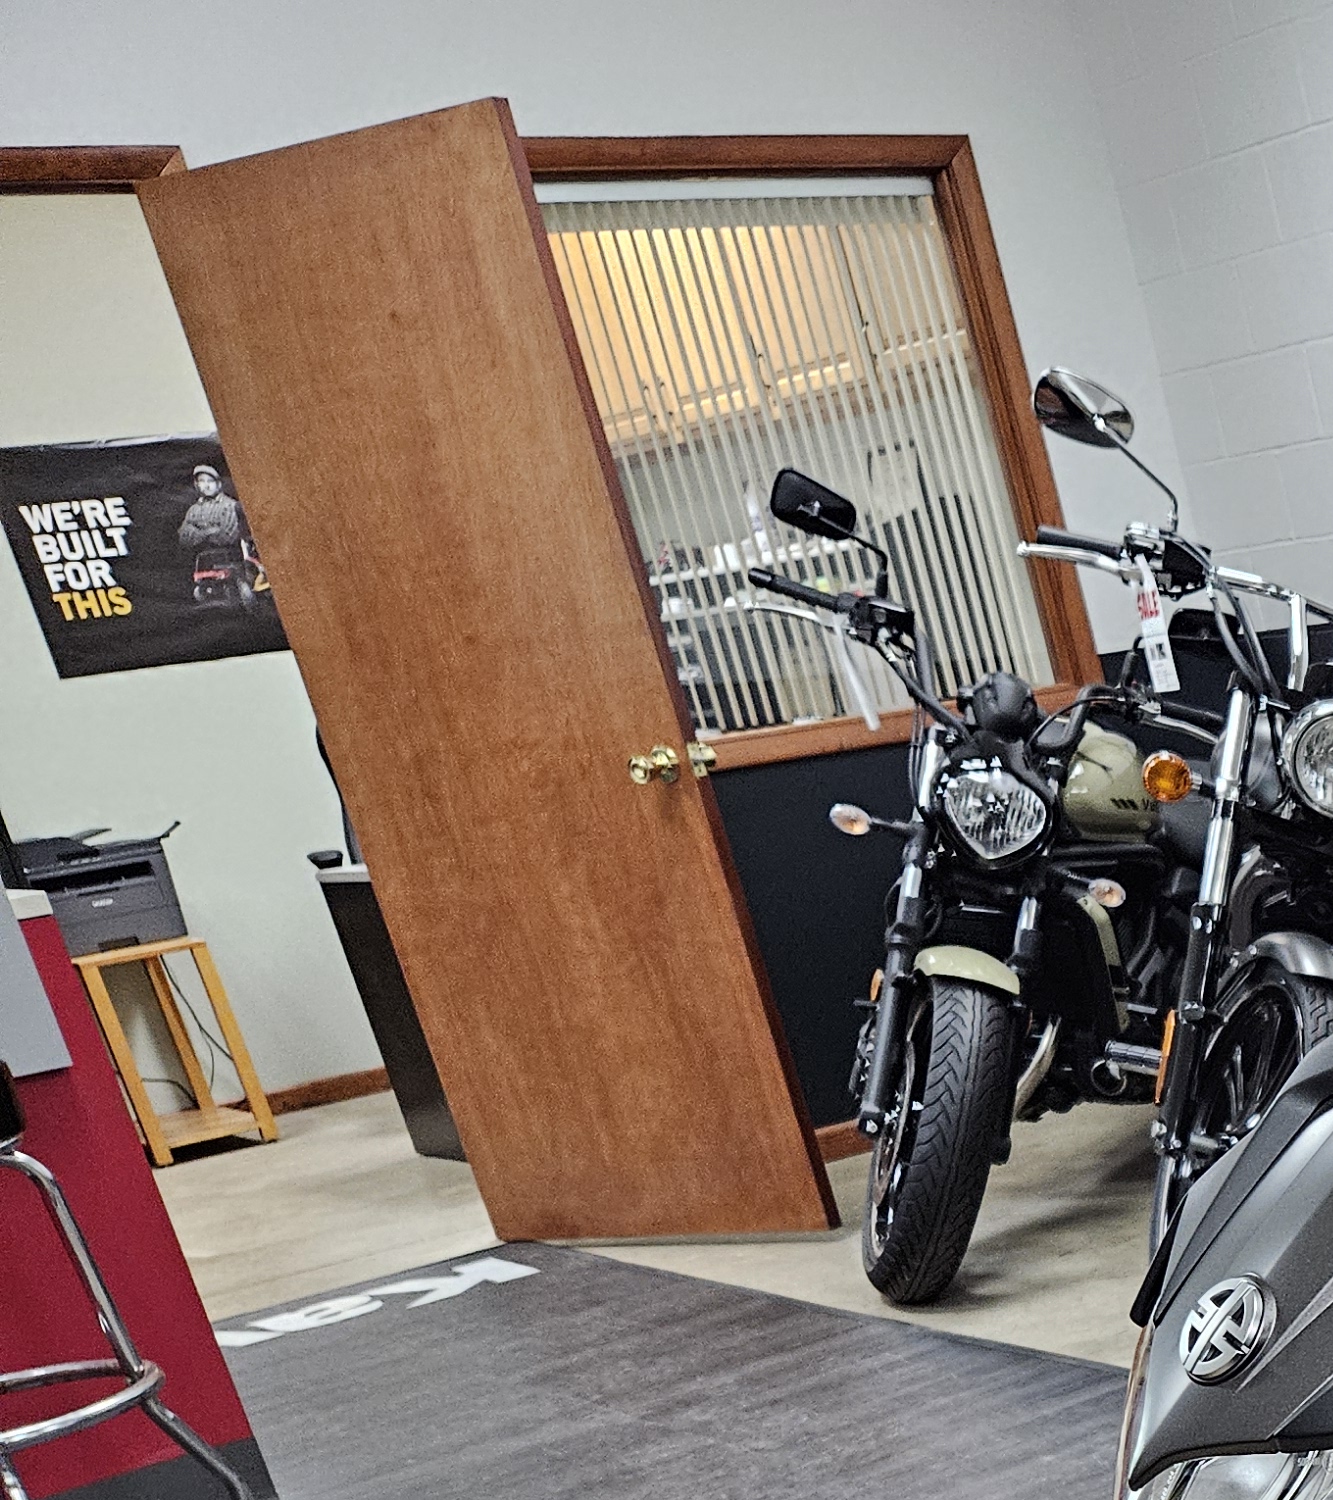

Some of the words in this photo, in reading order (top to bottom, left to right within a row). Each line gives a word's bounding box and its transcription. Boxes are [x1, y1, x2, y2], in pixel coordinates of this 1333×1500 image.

[18, 496, 133, 534] WE'RE
[32, 526, 129, 564] BUILT
[43, 558, 117, 593] FOR
[52, 587, 133, 621] THIS
